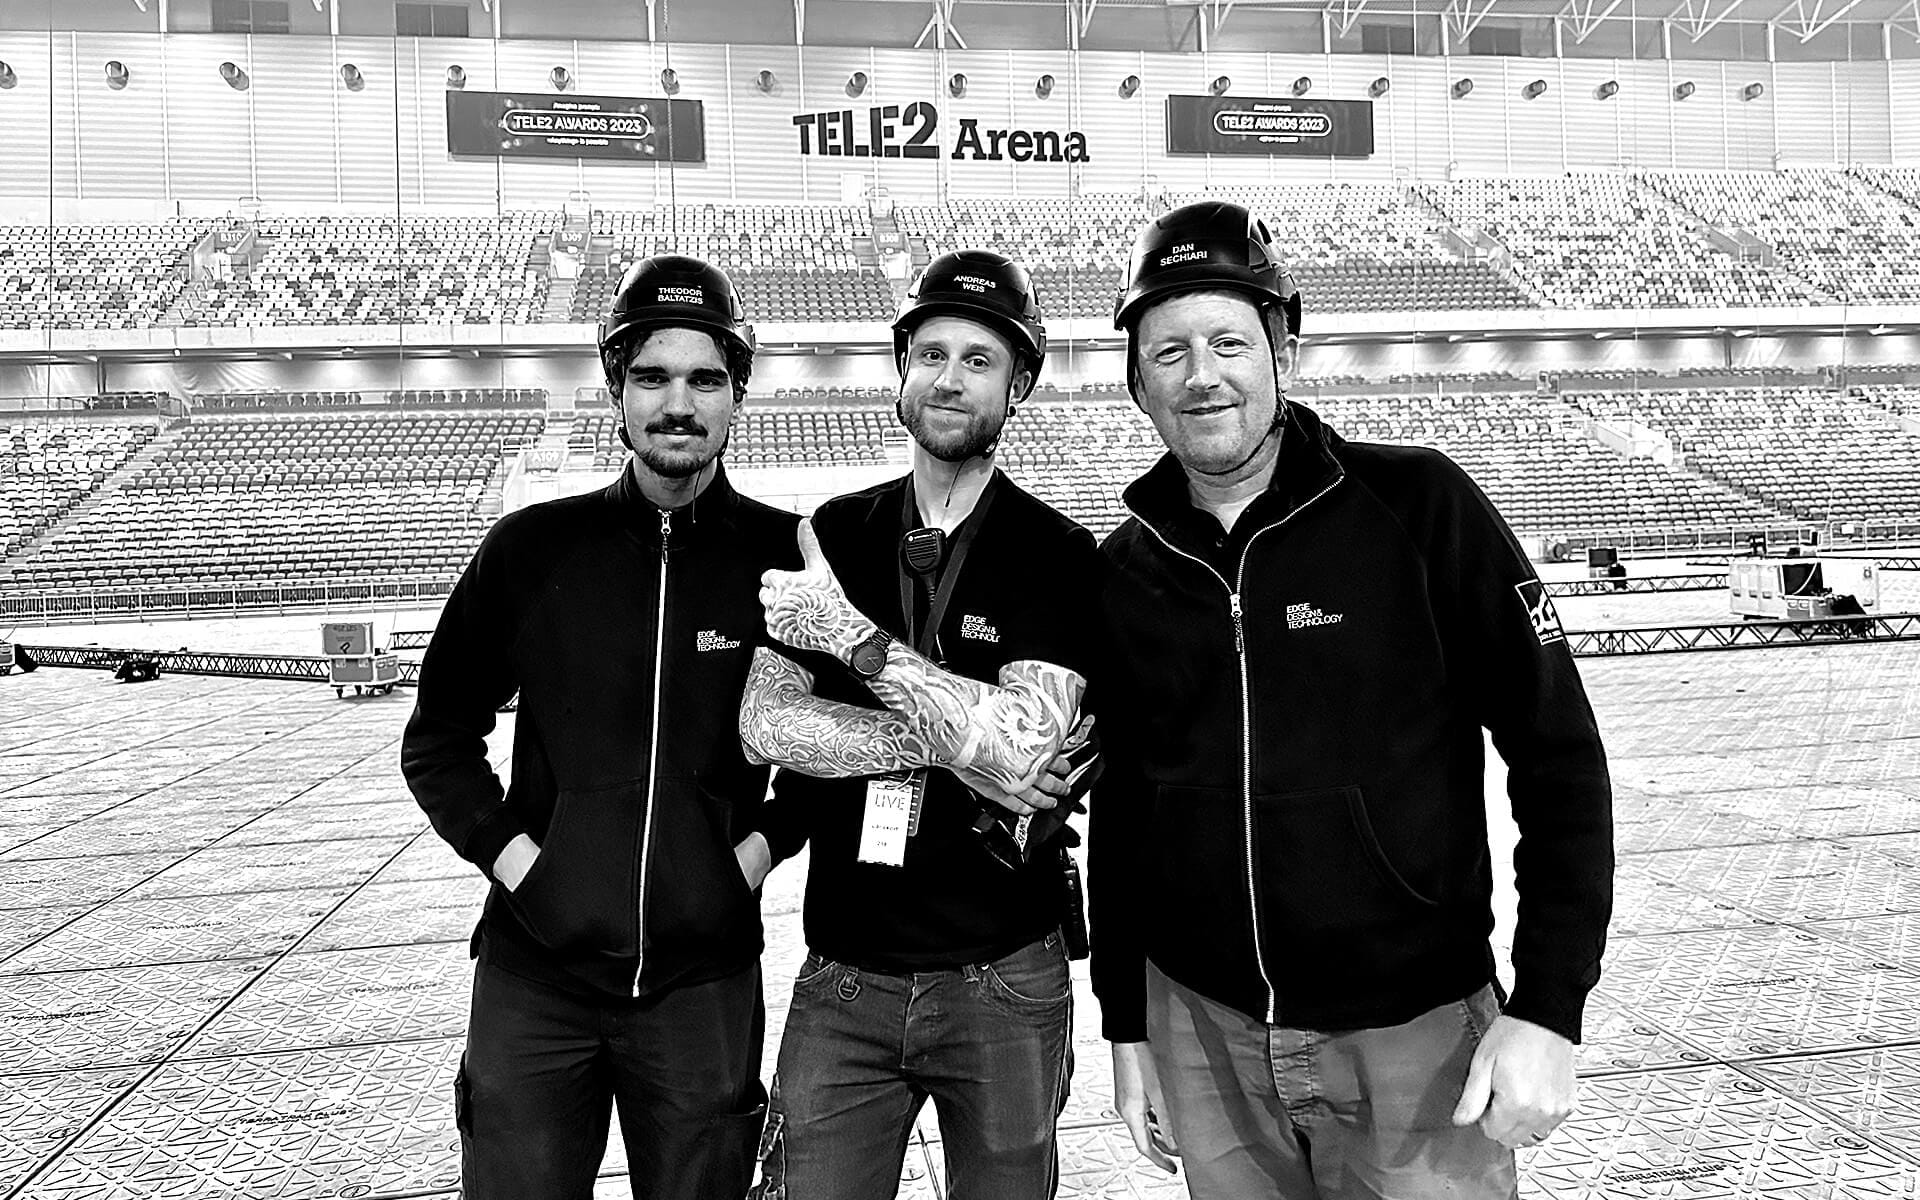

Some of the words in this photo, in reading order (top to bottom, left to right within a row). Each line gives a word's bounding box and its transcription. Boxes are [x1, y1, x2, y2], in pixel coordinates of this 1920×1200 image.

[513, 116, 553, 130] TELE2
[554, 117, 608, 132] AWARDS
[609, 119, 642, 133] 2023
[1222, 116, 1254, 129] TELE2
[1254, 117, 1298, 131] AWARDS
[1298, 118, 1325, 131] 2023
[793, 101, 939, 159] TELE2
[951, 119, 1090, 162] Arena
[1172, 243, 1195, 255] DAN
[1160, 250, 1208, 267] SECHIARI
[953, 274, 997, 289] ANDREAS
[962, 282, 986, 293] WEIS
[658, 287, 703, 297] THEODOR
[657, 294, 704, 305] BALTATZIS
[1286, 602, 1311, 614] EDGE
[963, 614, 987, 625] EDGE
[1287, 613, 1344, 630] TECHNOLOGY
[697, 629, 717, 638] EDGE
[697, 640, 741, 652] TECHNOLOGY
